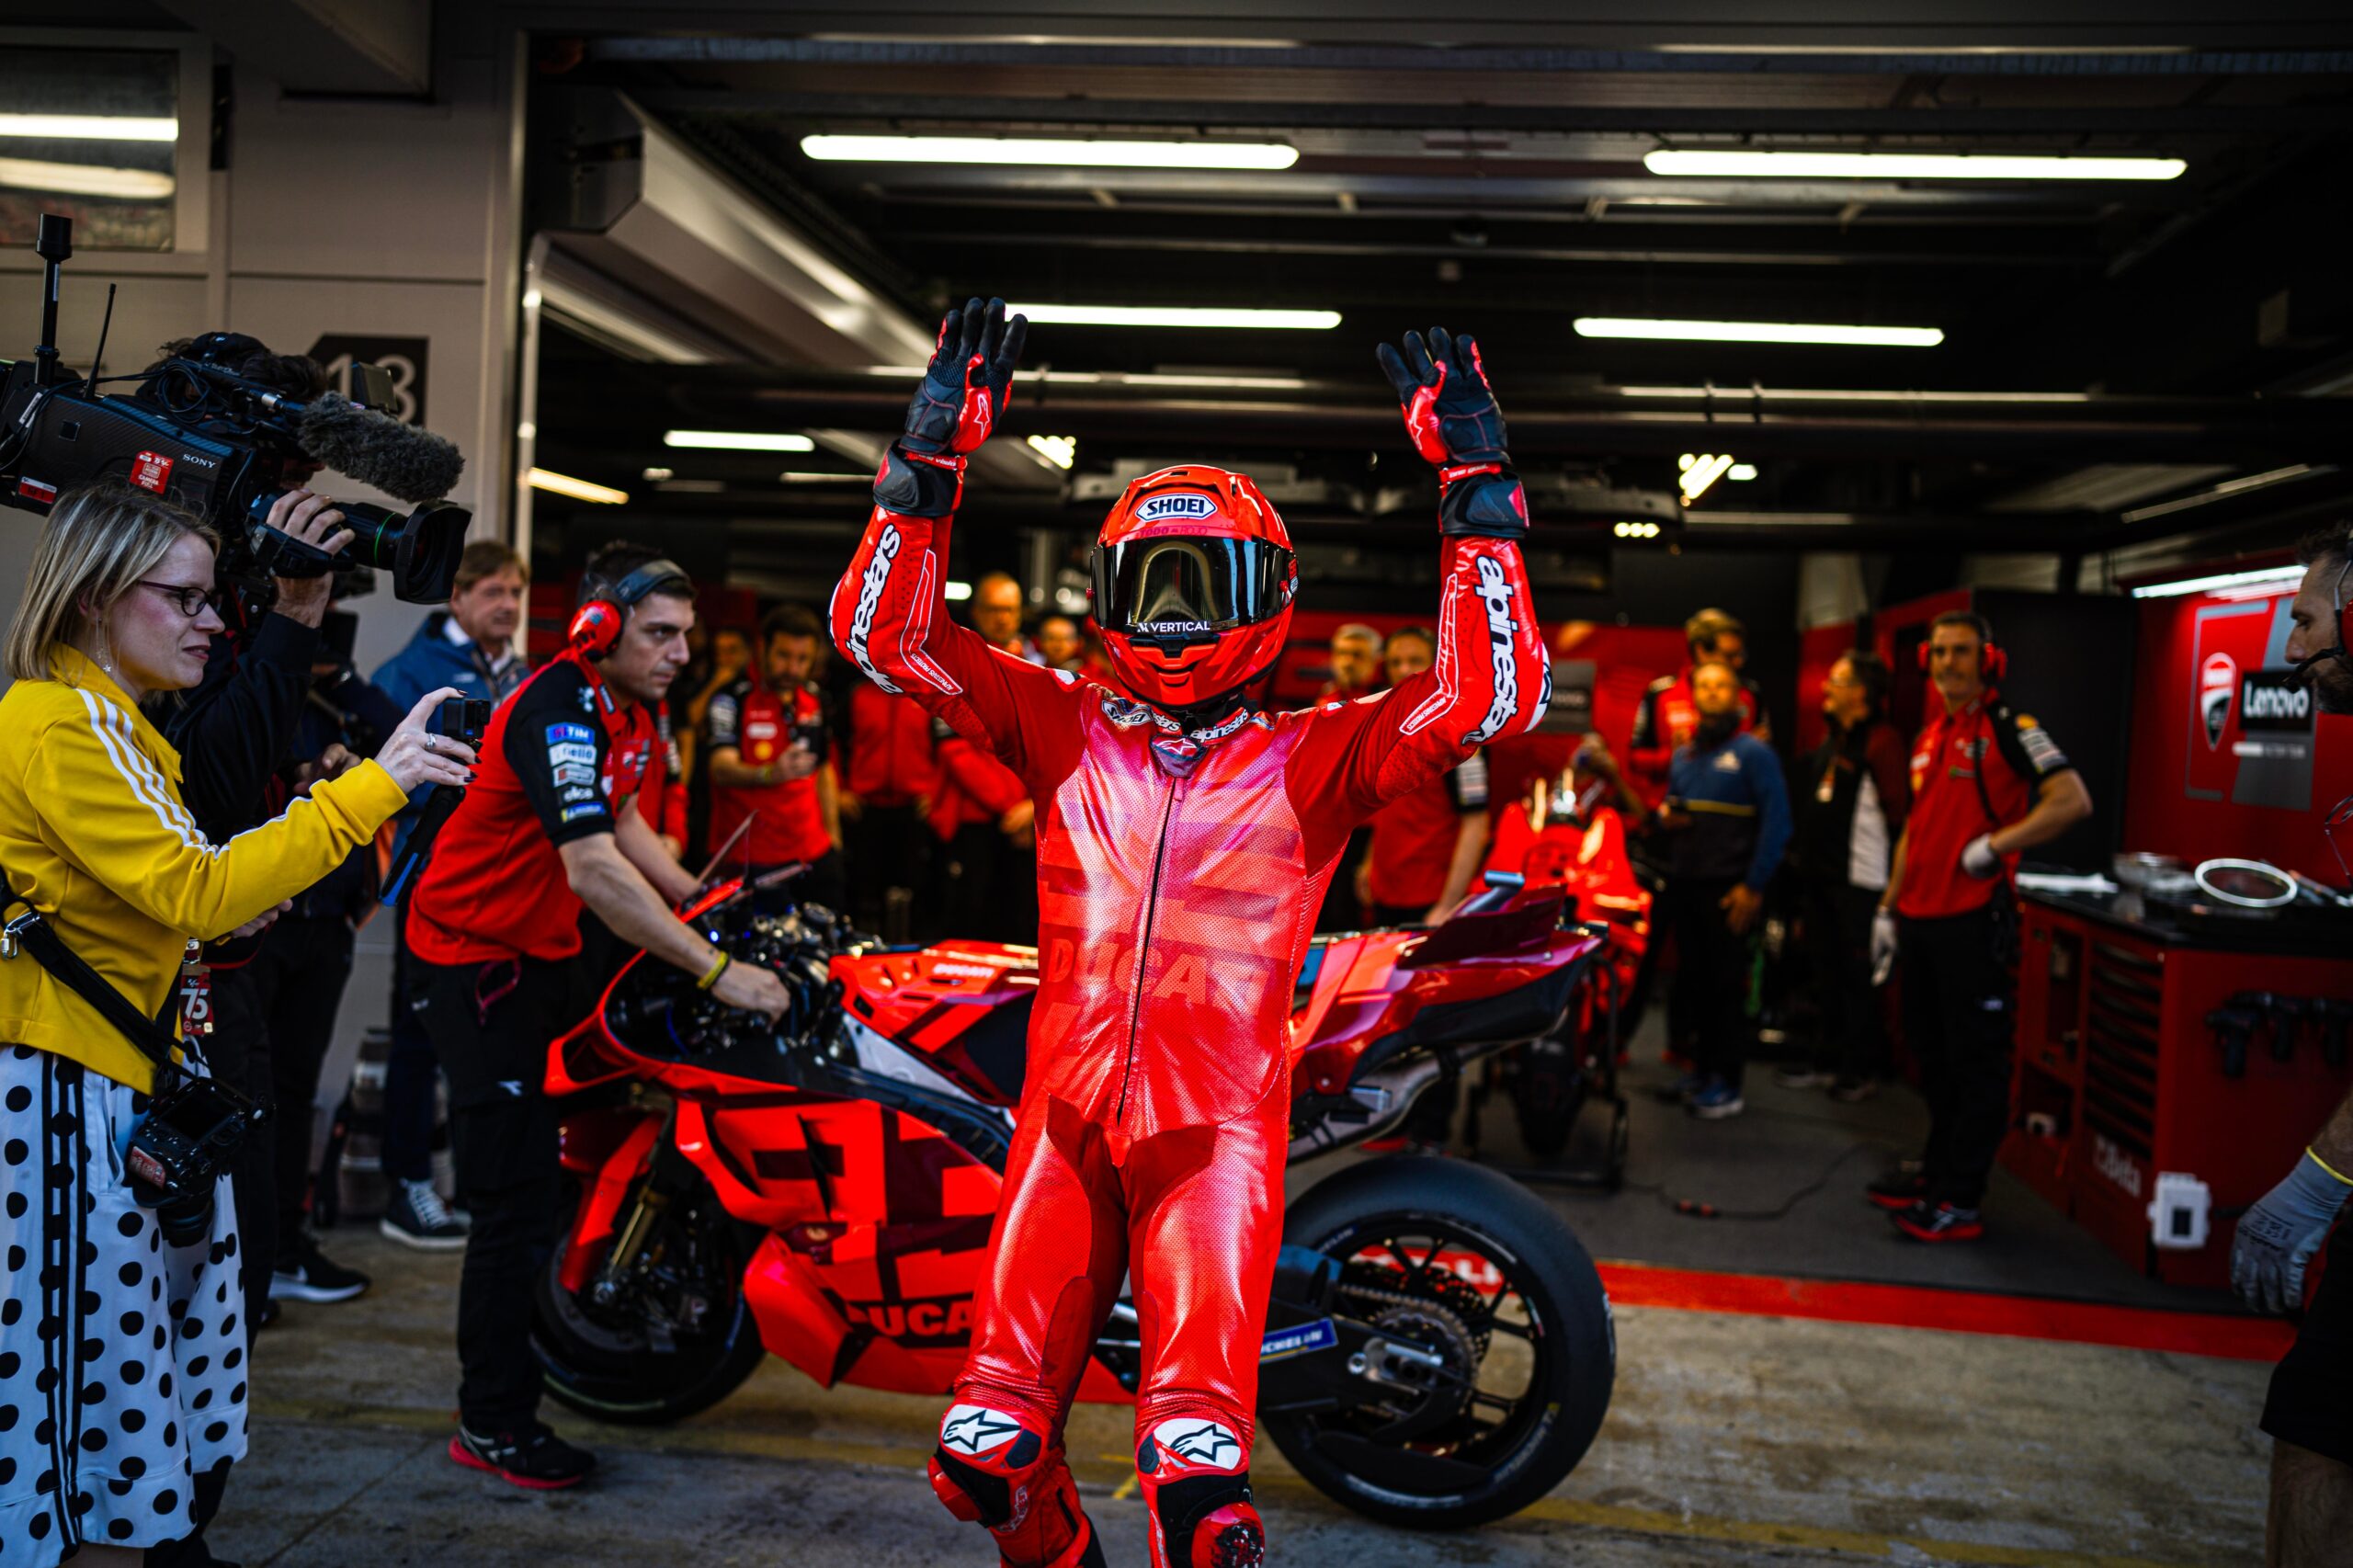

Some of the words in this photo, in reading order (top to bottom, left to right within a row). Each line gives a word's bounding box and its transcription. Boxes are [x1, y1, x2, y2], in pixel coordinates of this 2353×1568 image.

[326, 353, 417, 424] 13
[183, 453, 217, 470] SONY
[1146, 497, 1205, 517] SHOEI
[1140, 527, 1170, 537] TODO
[1180, 526, 1208, 536] ROJO
[845, 523, 904, 695] alpinestars
[1150, 620, 1211, 632] VERTICAL
[910, 653, 931, 674] PROTECTS
[2243, 679, 2310, 719] Lenovo
[1107, 706, 1145, 724] SHOEI
[567, 726, 589, 740] TIM
[1190, 708, 1249, 744] alpinestars
[180, 988, 209, 1020] 75
